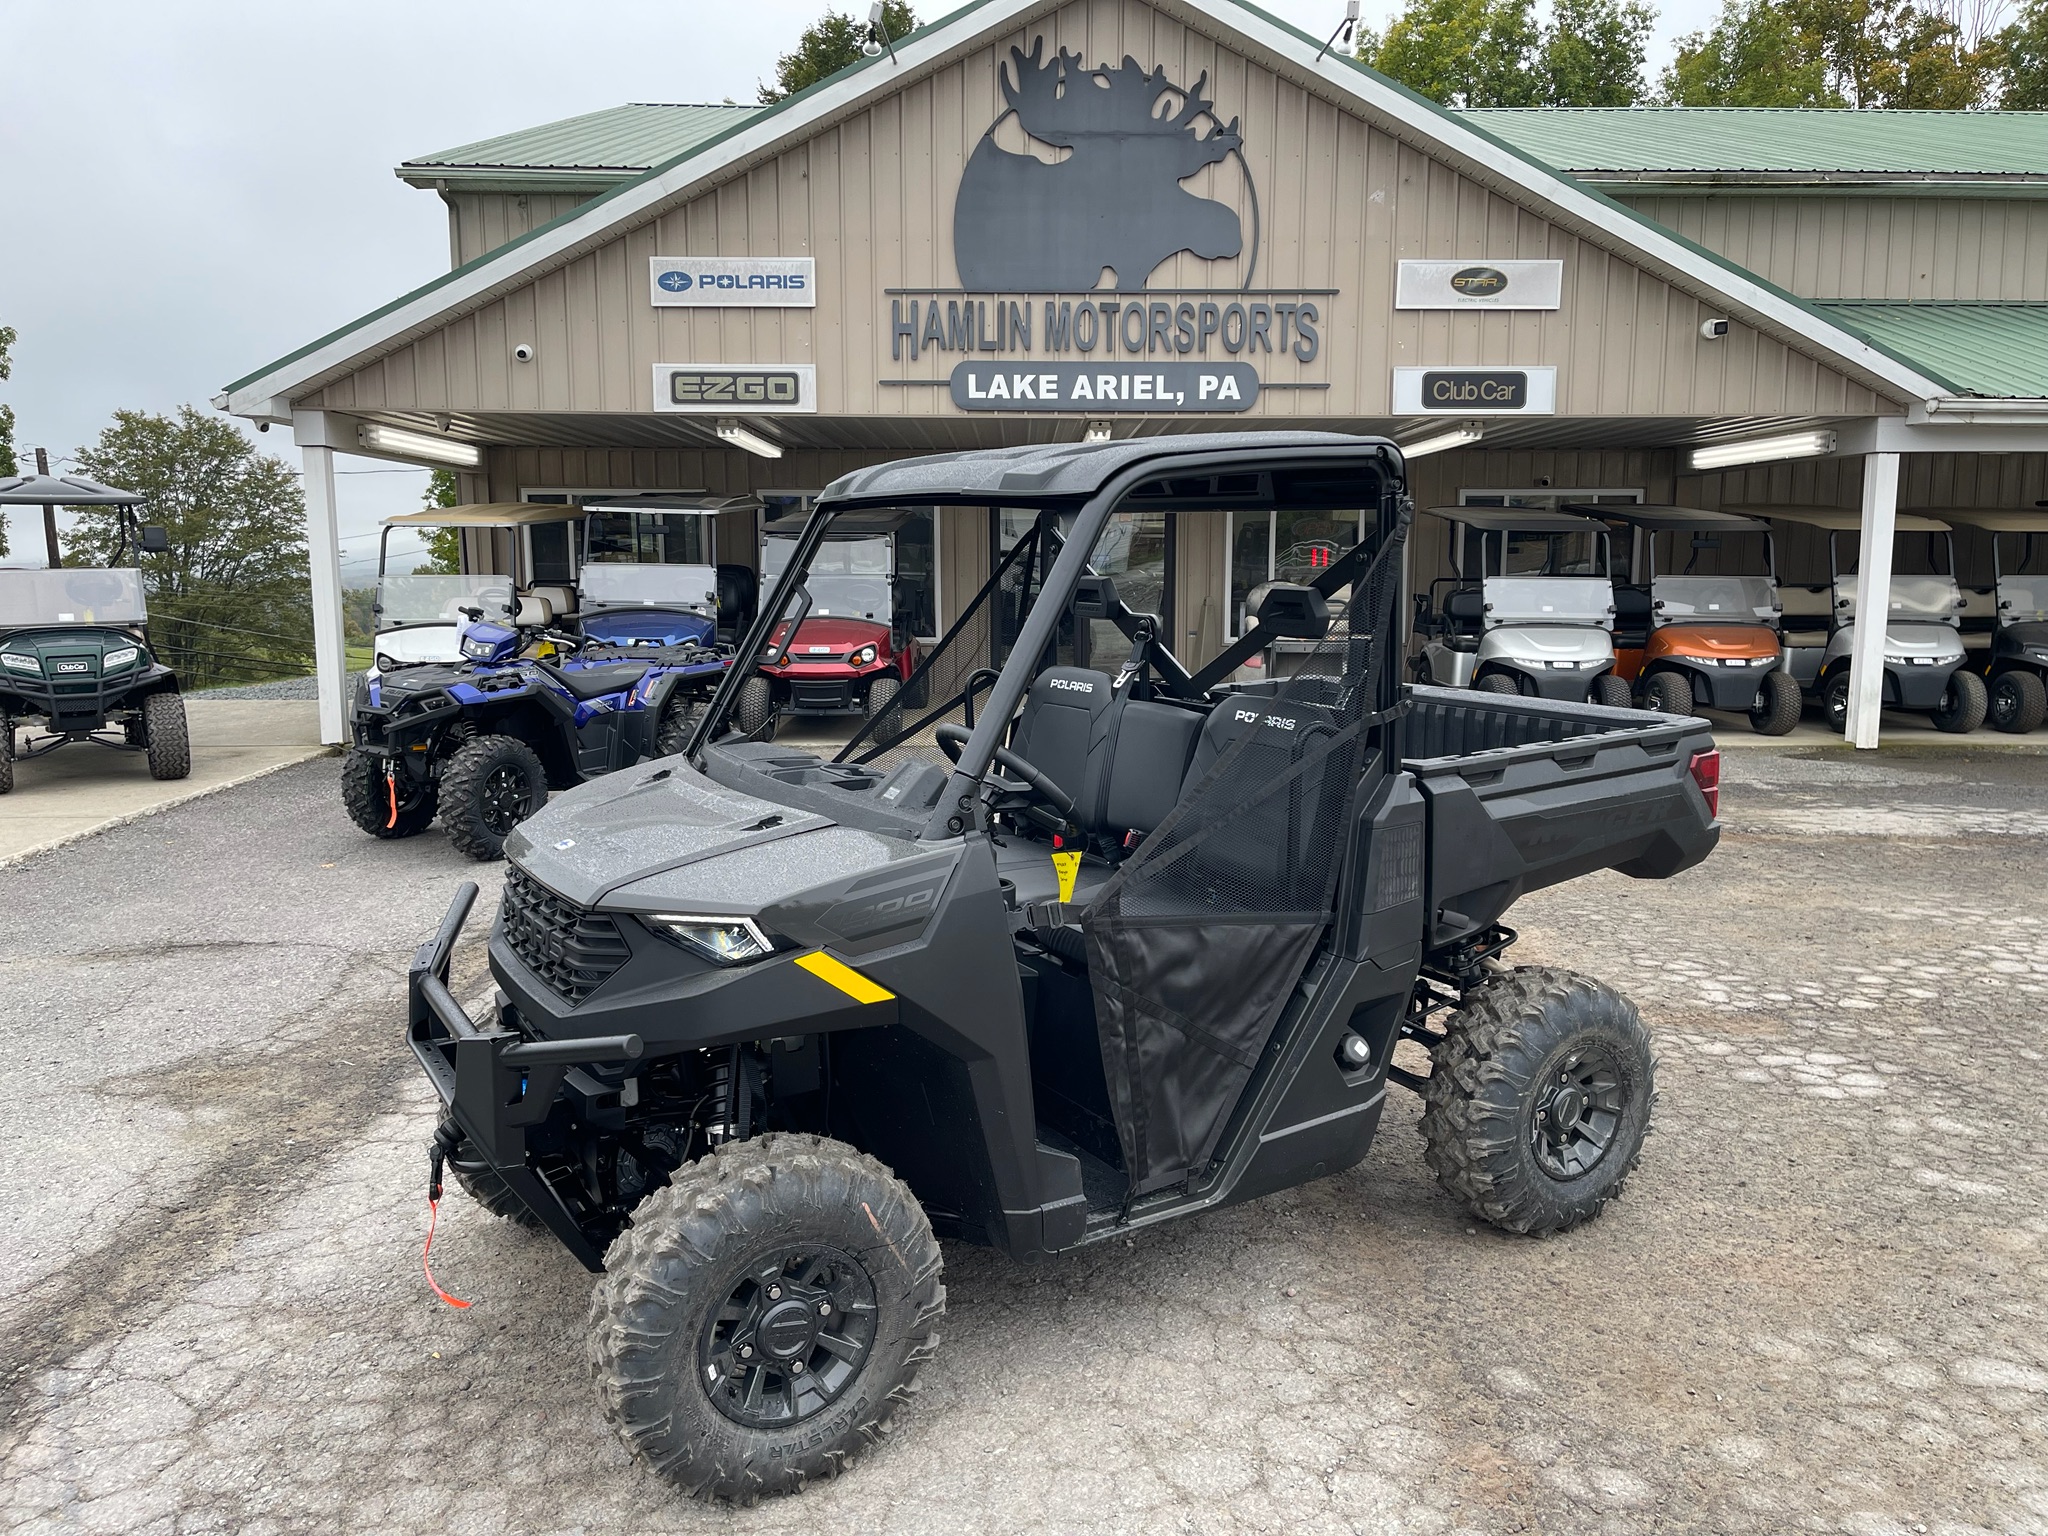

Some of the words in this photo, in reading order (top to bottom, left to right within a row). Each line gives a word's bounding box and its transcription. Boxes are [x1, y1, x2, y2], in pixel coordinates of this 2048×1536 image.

[699, 275, 805, 289] POLARIS
[1454, 277, 1498, 287] STAR
[892, 299, 1032, 361] HAMLIN
[1045, 301, 1319, 363] MOTORSPORTS
[674, 376, 796, 401] EZGO
[967, 373, 1058, 400] LAKE
[1071, 374, 1185, 406] ARIEL,
[1199, 375, 1242, 400] PA
[1433, 380, 1479, 401] Club
[1480, 380, 1517, 401] Car
[1049, 678, 1094, 694] POLARIS
[1234, 708, 1298, 731] POARIS
